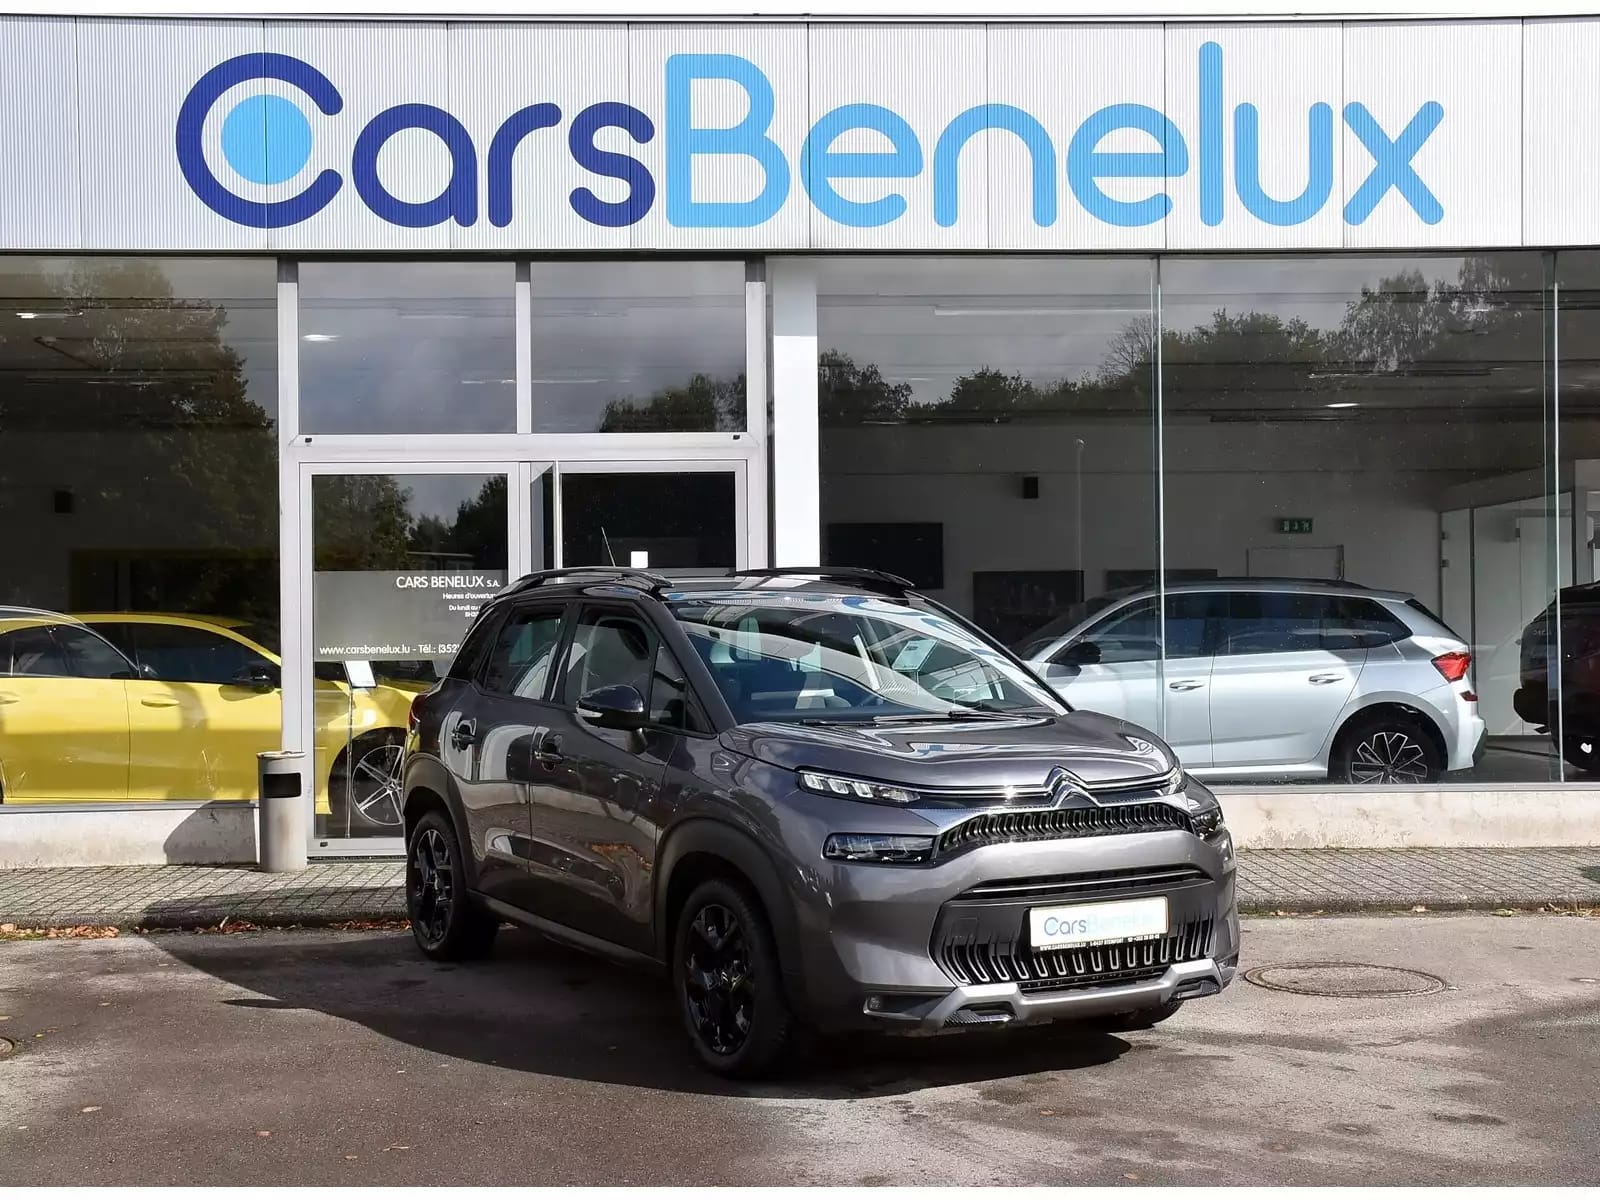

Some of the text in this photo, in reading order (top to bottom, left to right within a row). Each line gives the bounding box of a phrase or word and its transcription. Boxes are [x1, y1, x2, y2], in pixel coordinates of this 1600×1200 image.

[176, 41, 1444, 228] CarsBenelux
[396, 576, 429, 588] CARS
[431, 576, 484, 588] BENELUX
[319, 644, 410, 655] www.carsbenelux.lu
